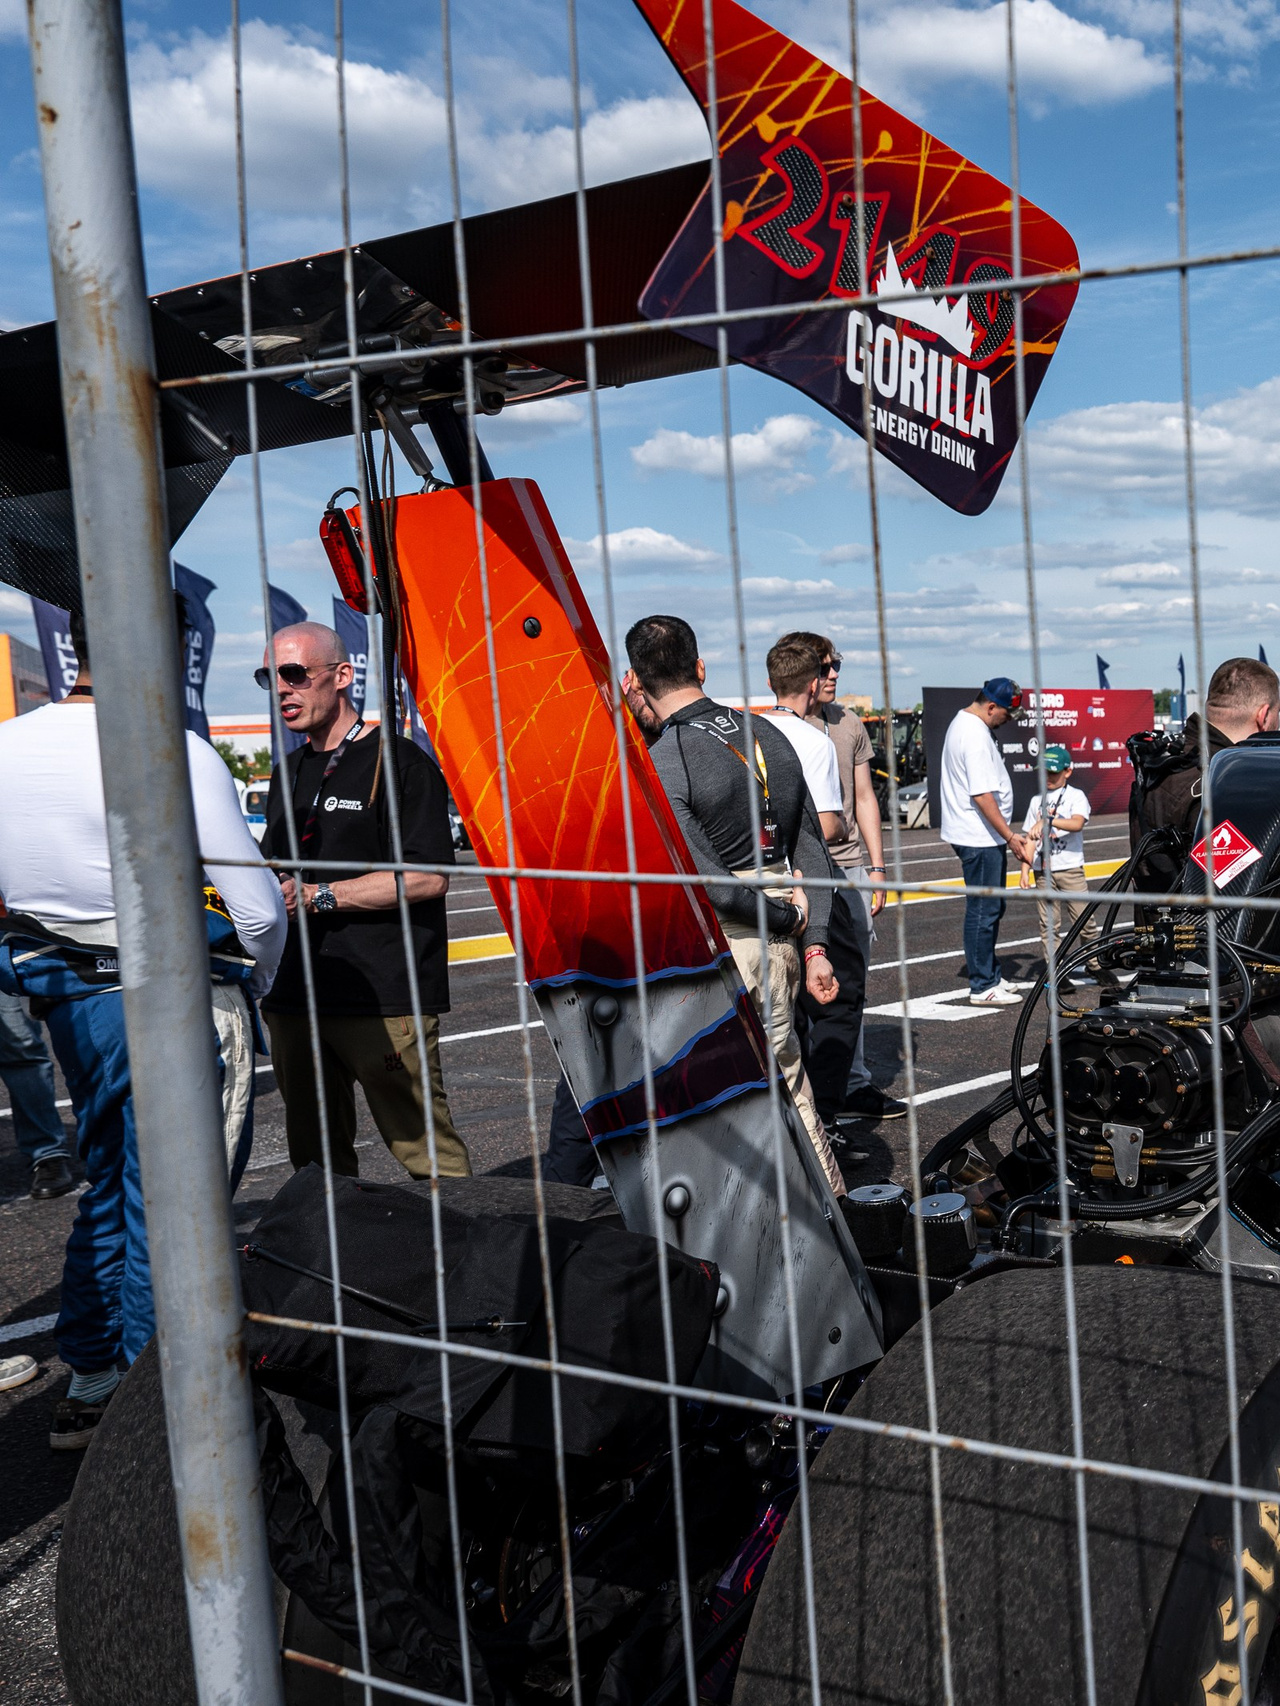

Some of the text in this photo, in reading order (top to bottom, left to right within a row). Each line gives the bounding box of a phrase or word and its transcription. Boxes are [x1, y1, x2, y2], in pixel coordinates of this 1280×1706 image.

[846, 310, 994, 445] GORILLA
[869, 404, 976, 471] ENERGY DRINK
[1196, 850, 1226, 858] FLAABLE
